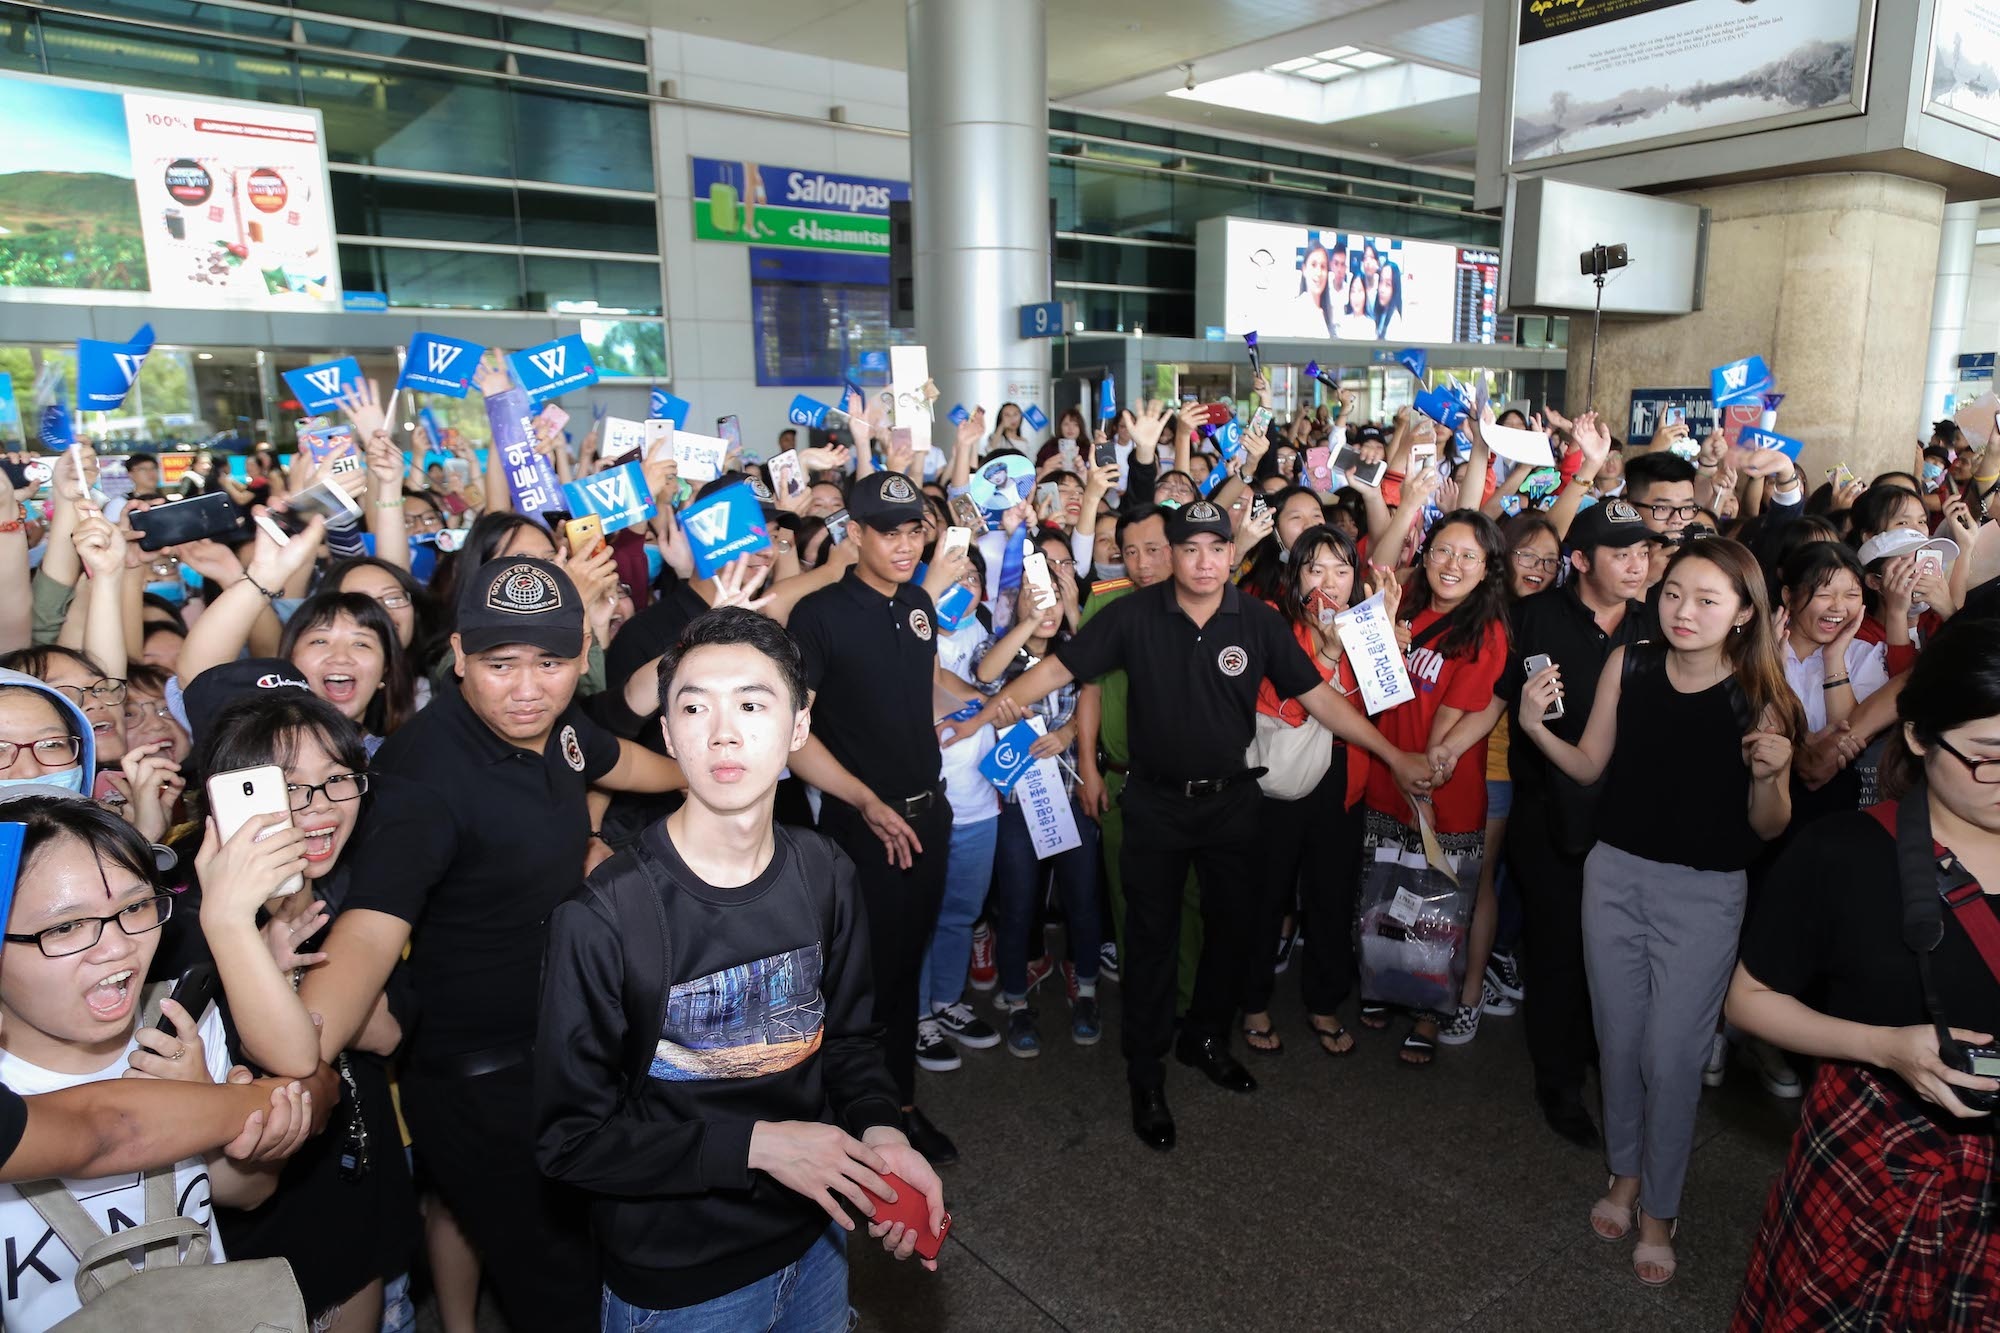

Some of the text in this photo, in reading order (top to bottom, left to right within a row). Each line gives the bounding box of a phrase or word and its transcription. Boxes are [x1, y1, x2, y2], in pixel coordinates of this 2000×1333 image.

[786, 172, 891, 213] Salonpas
[788, 219, 891, 247] Hisamitsu
[1035, 307, 1048, 333] 9
[1973, 354, 1983, 367] 7
[586, 472, 629, 512] W
[491, 566, 558, 597] GOLDEN EYE SECURITY
